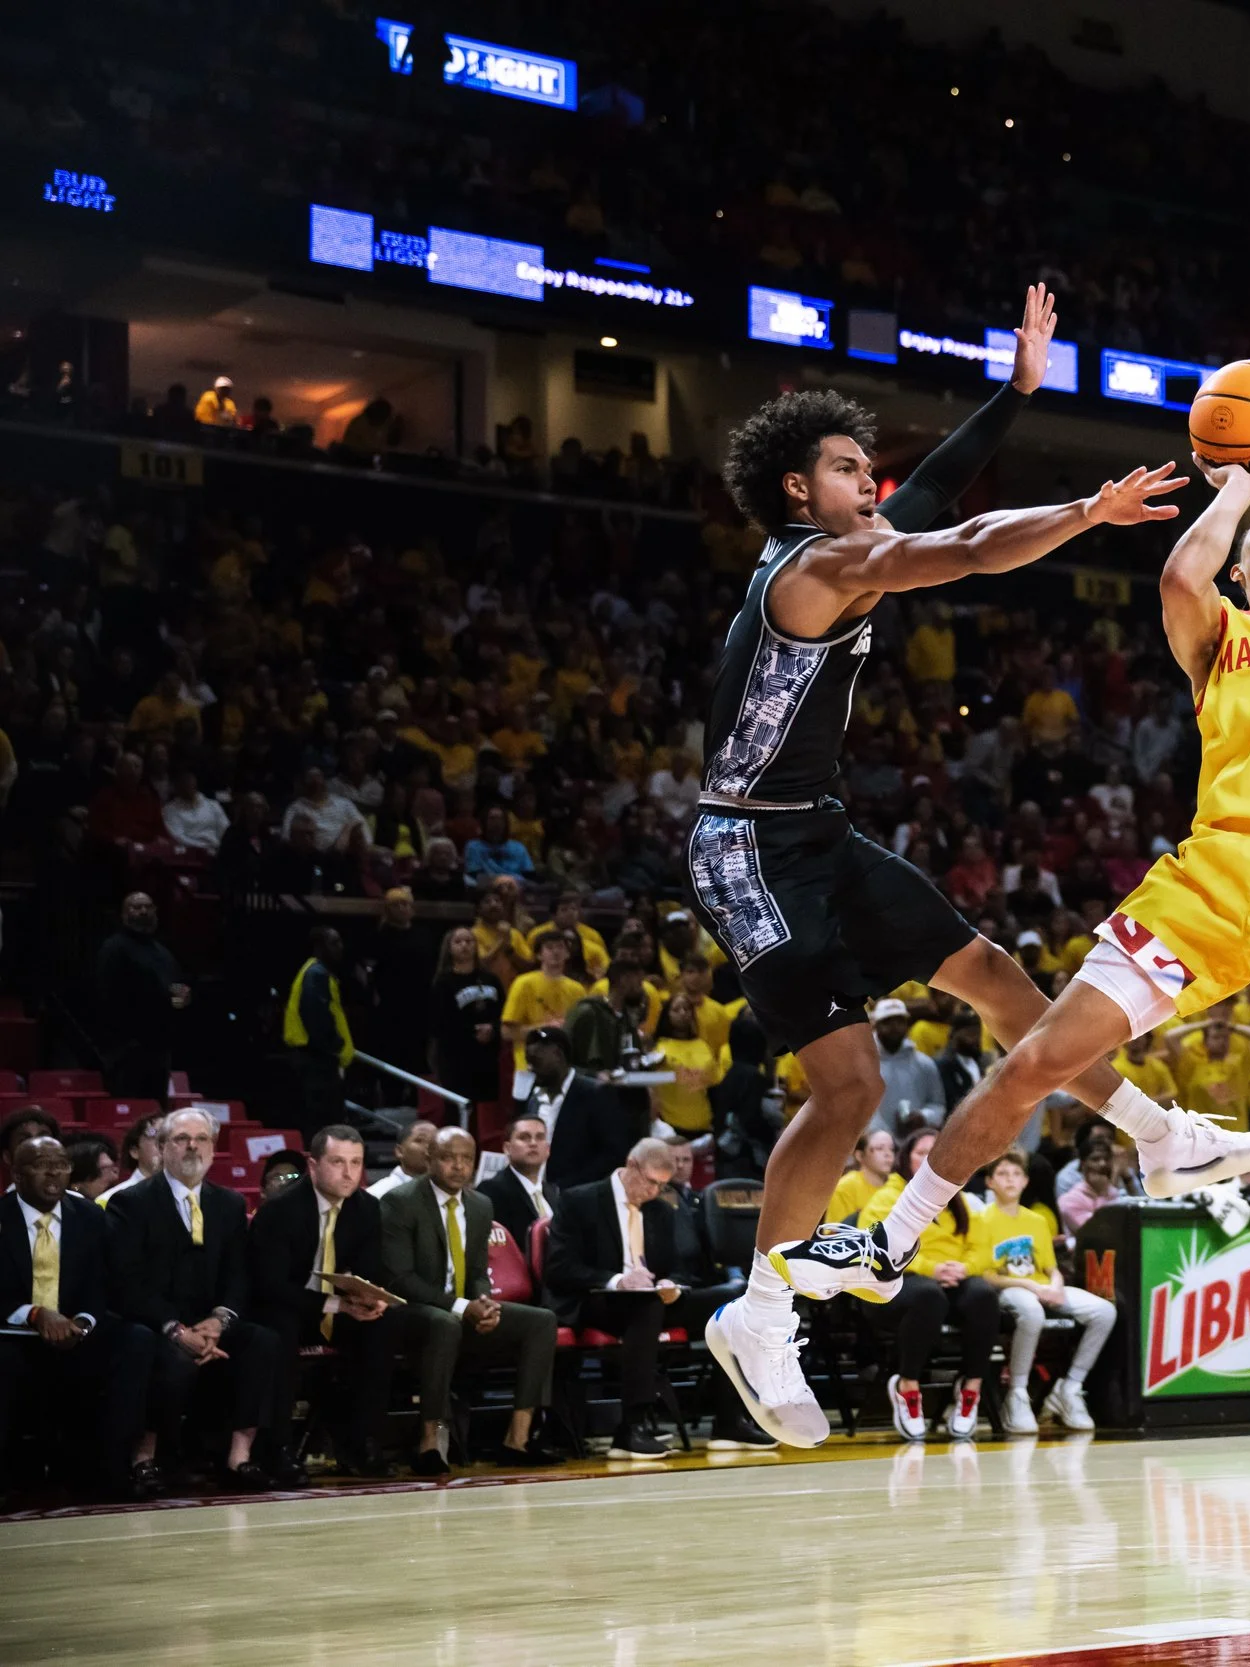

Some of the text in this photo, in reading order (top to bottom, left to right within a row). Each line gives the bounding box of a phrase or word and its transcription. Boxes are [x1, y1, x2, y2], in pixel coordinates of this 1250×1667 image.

[43, 182, 116, 213] LIGHT
[54, 168, 108, 194] BUD
[565, 270, 663, 306] Responsibly
[1085, 1250, 1116, 1304] M
